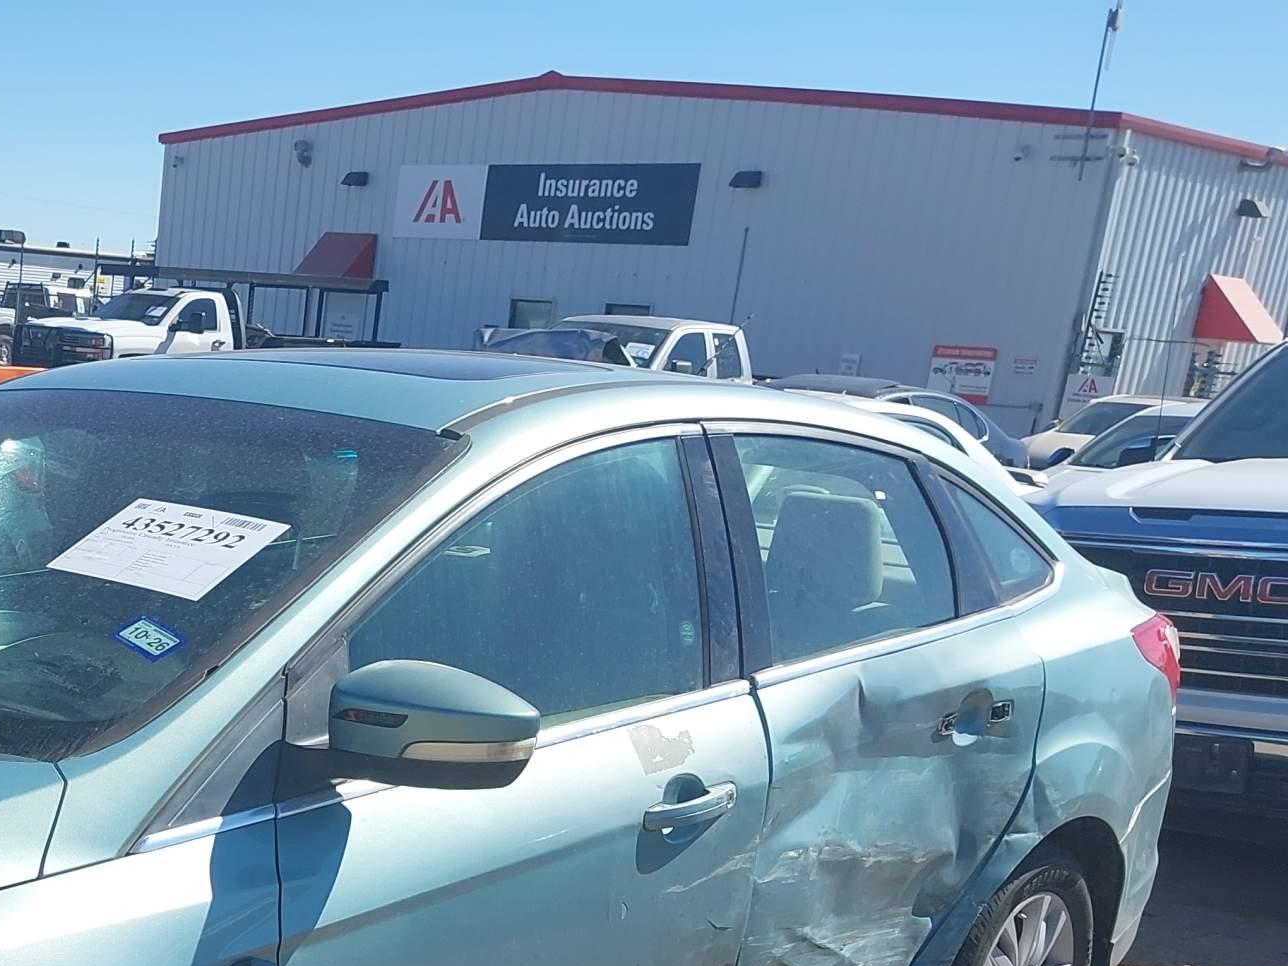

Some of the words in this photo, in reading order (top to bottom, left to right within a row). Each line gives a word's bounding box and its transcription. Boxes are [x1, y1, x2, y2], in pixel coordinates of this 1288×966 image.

[538, 172, 638, 198] Insurance
[513, 203, 559, 229] Auto
[564, 204, 655, 231] Auctions
[121, 516, 247, 549] 43527292
[1144, 568, 1288, 605] GMC
